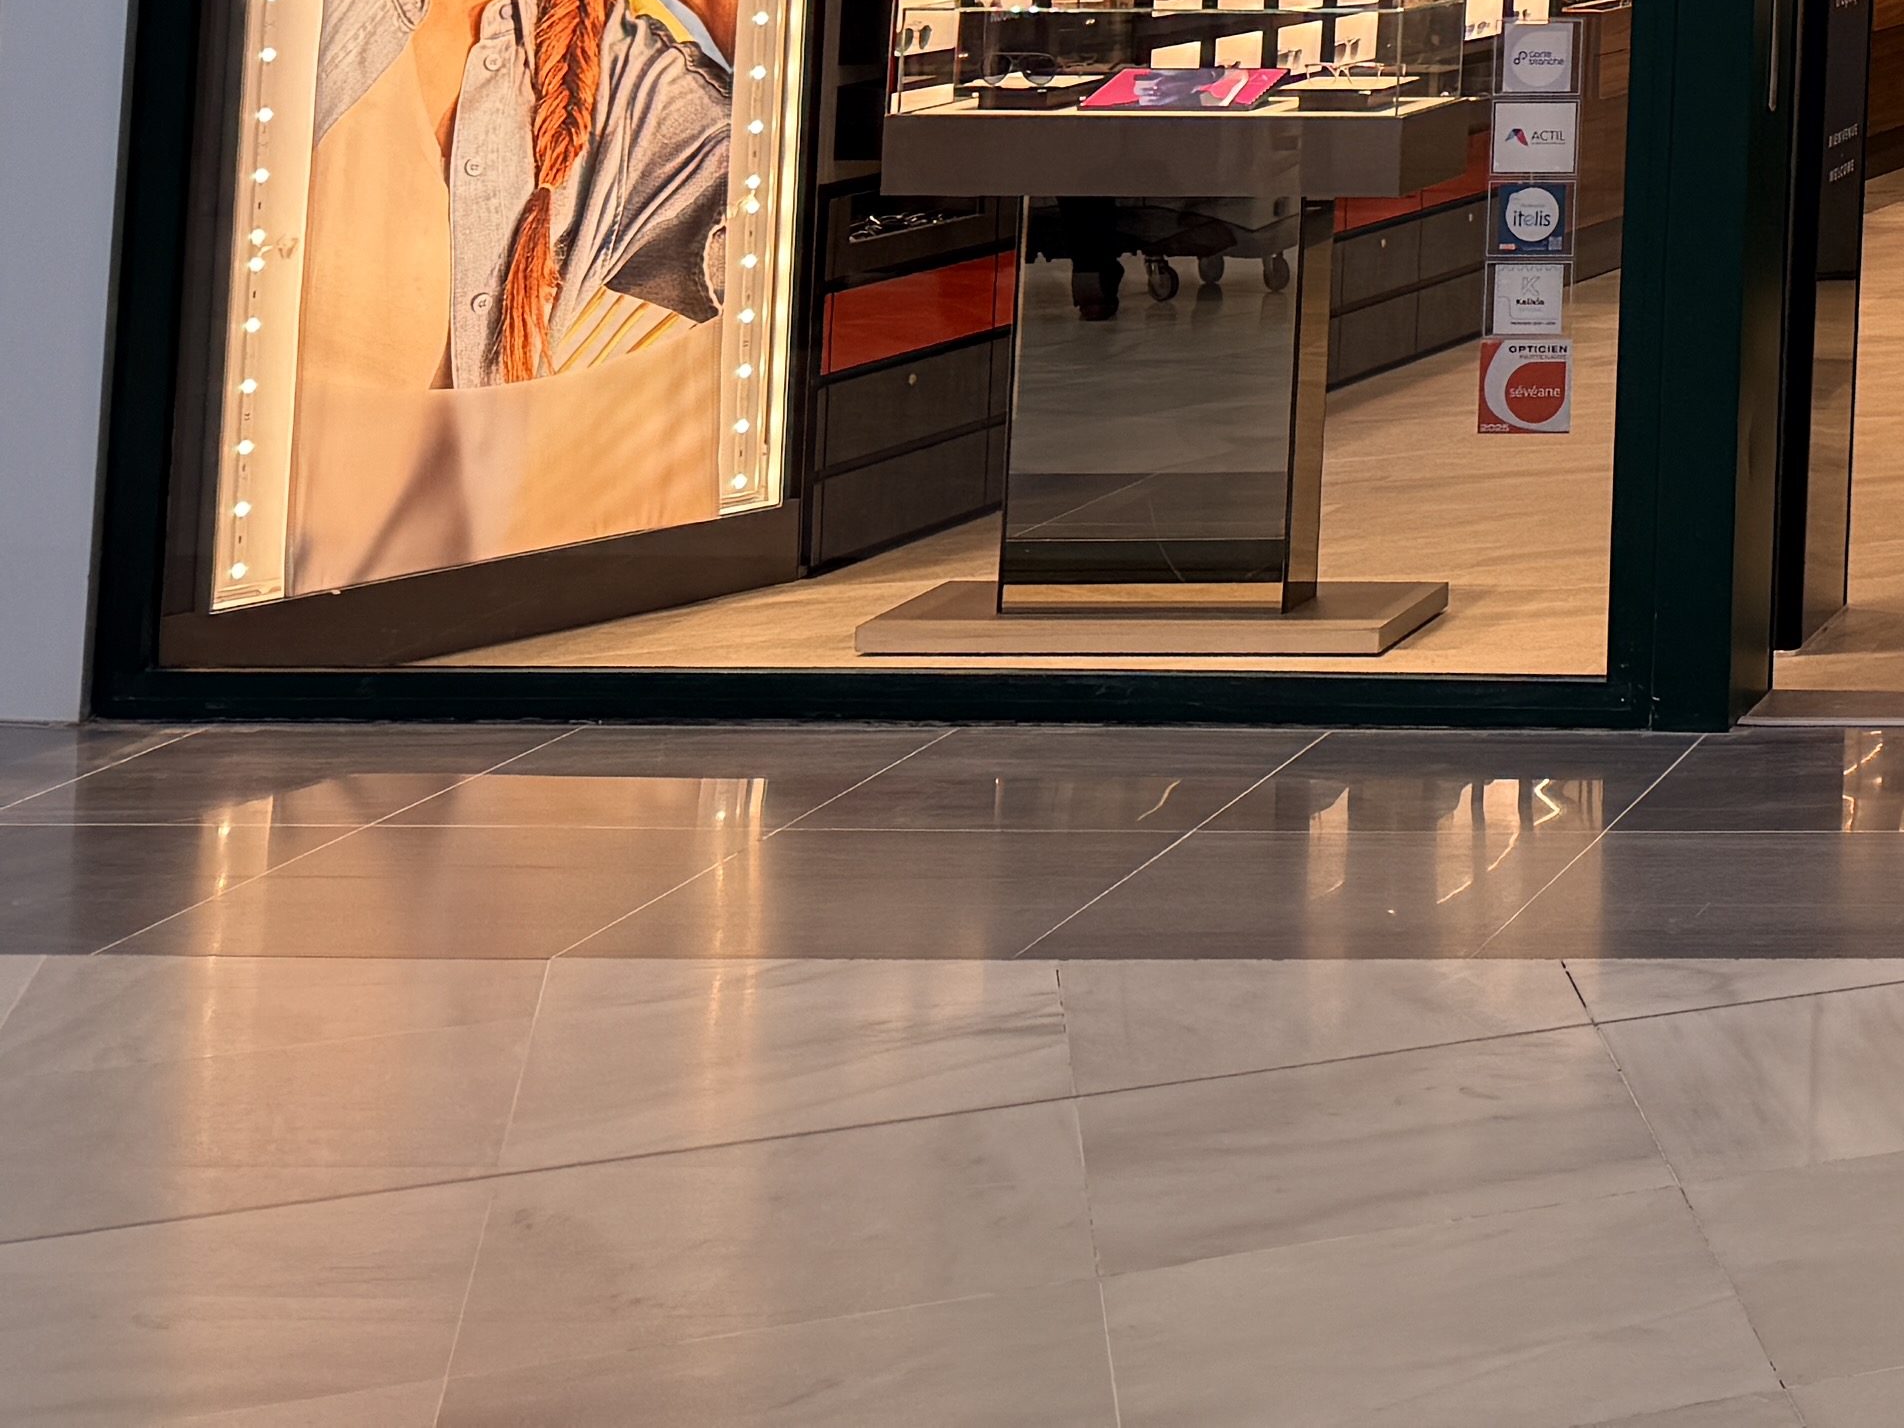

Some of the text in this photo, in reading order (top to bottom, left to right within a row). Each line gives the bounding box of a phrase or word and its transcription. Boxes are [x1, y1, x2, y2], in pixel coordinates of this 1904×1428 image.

[1531, 130, 1566, 141] ACTIL
[1513, 210, 1551, 227] itelis
[1508, 345, 1568, 353] OPTICIEN
[1509, 385, 1561, 398] sévéane
